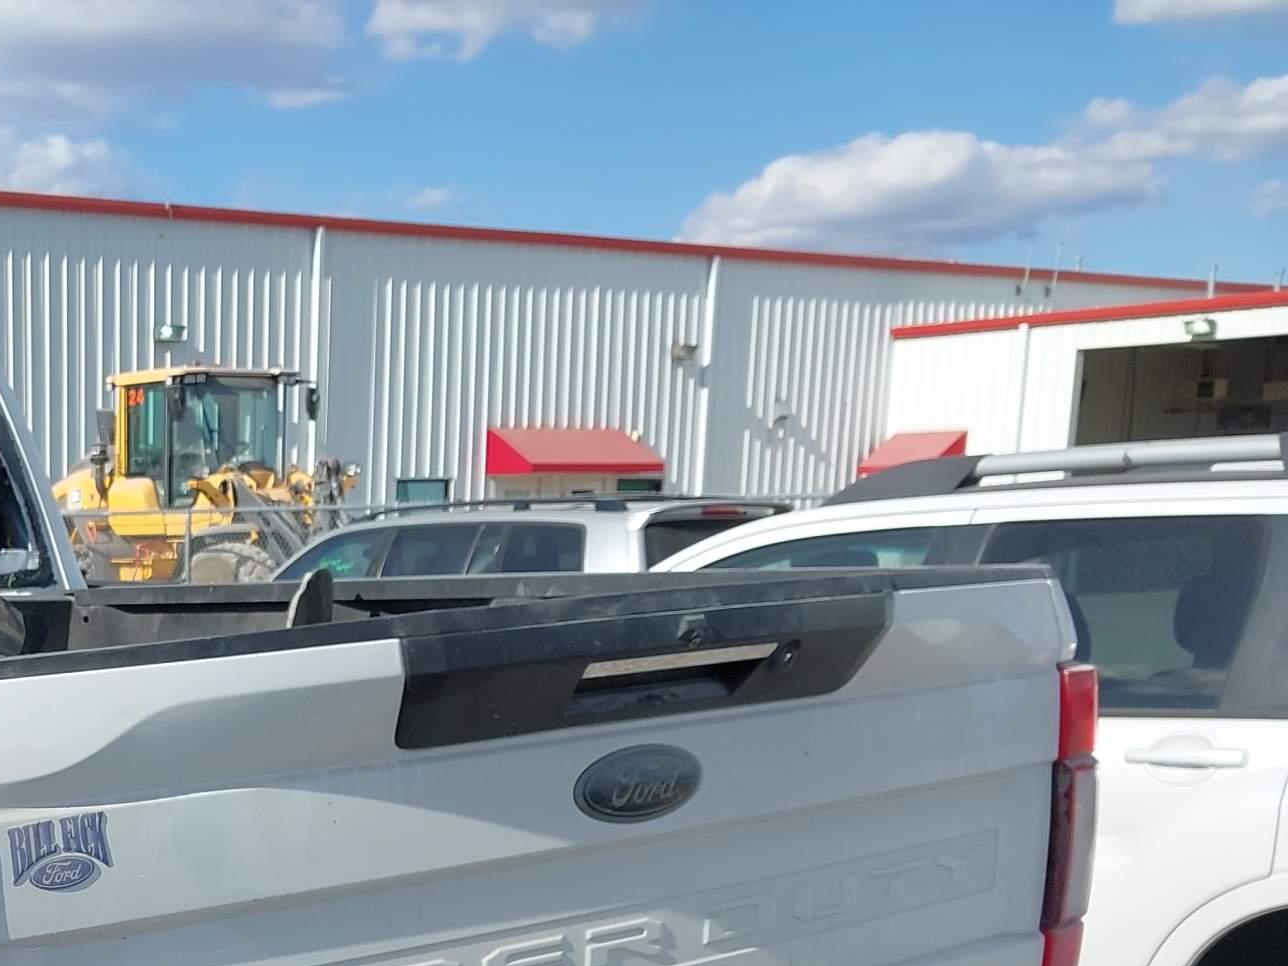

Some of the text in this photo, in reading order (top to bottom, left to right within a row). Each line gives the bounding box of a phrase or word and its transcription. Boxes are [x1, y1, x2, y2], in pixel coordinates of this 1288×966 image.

[611, 759, 680, 808] Ford
[8, 819, 58, 884] BILL
[42, 860, 82, 885] Ford
[703, 842, 987, 946] DUTY
